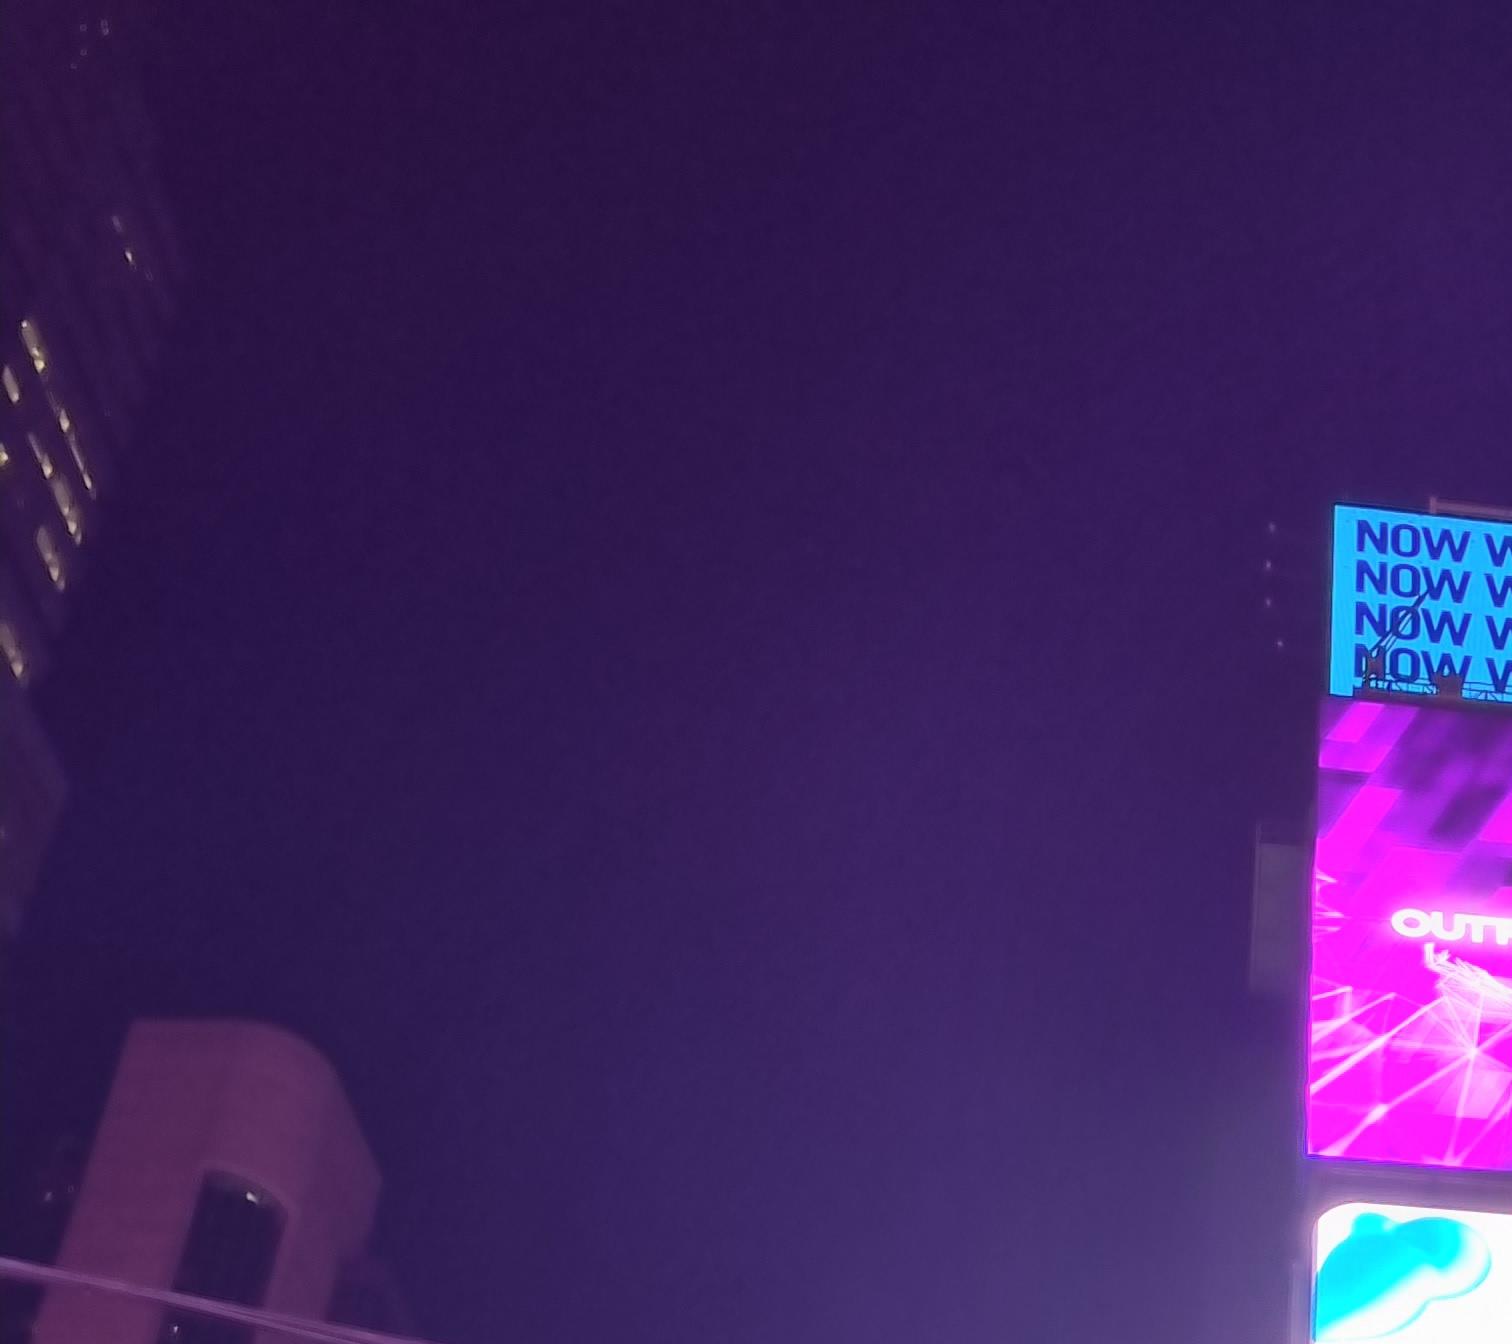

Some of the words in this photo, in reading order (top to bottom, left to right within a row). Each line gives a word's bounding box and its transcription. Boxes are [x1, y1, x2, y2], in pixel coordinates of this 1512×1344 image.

[1357, 519, 1472, 562] NOW
[1356, 560, 1472, 603] NOW
[1355, 601, 1472, 646] NOW
[1355, 643, 1472, 684] NOW
